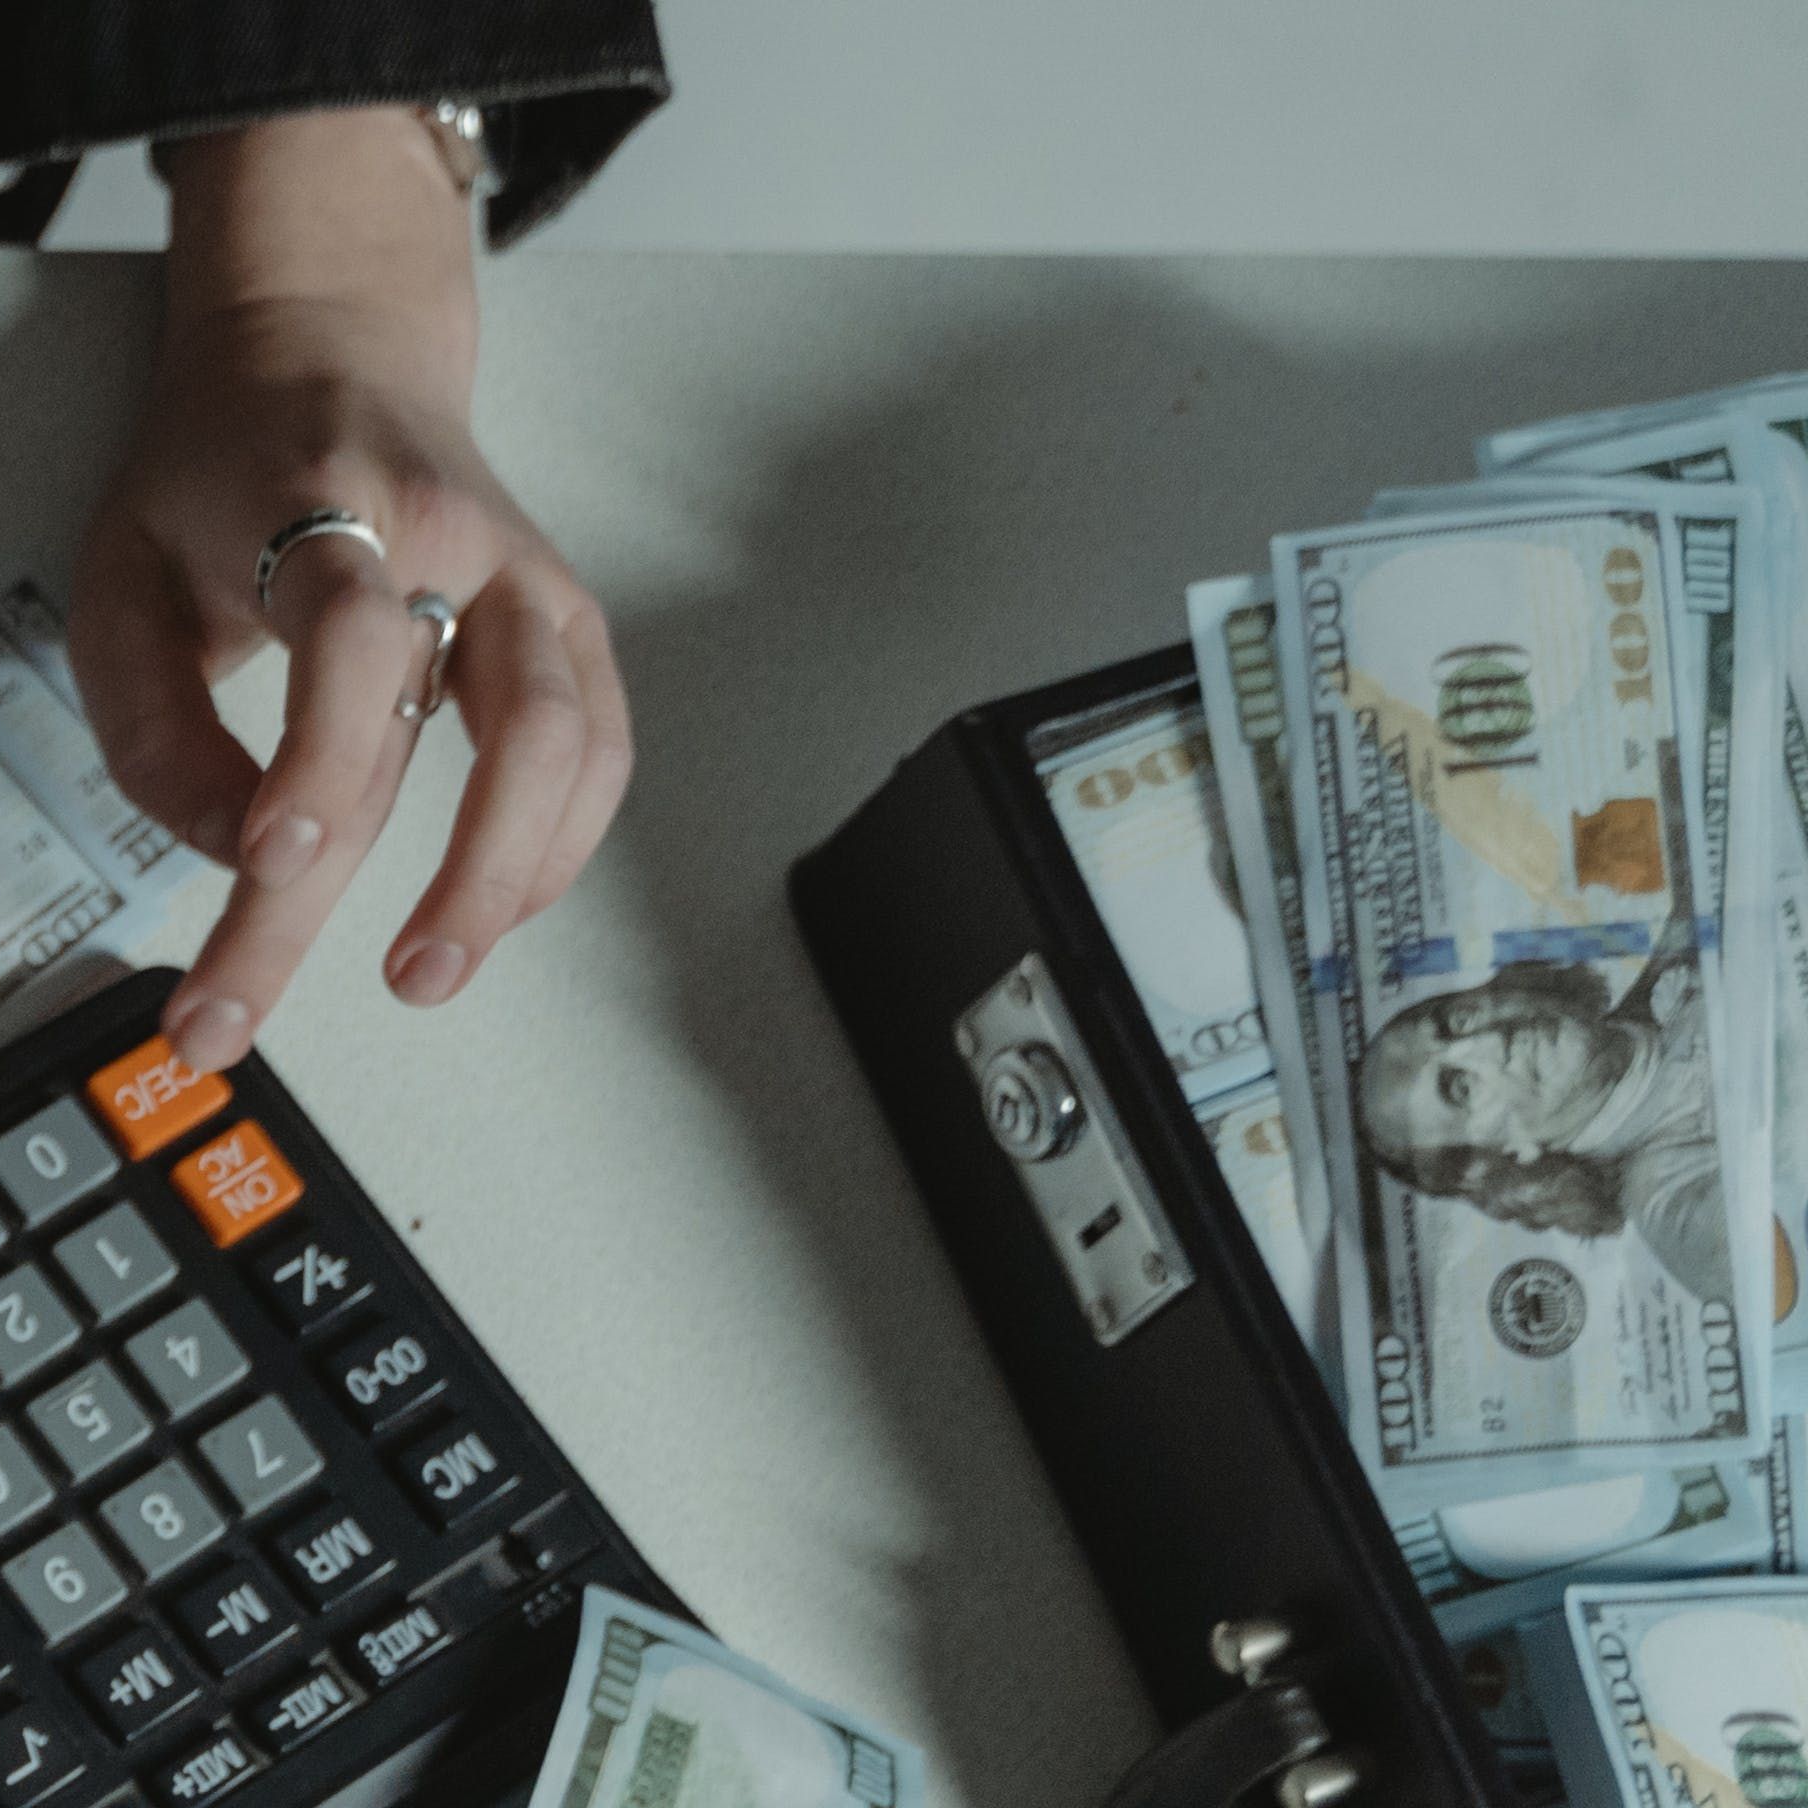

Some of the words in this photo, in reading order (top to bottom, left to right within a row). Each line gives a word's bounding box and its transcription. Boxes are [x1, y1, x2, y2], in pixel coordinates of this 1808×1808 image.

[1603, 547, 1653, 706] 100
[23, 1133, 67, 1180] 0
[198, 1135, 247, 1183] AC
[221, 1173, 277, 1220] ON
[95, 1238, 132, 1280] 1
[165, 1336, 200, 1379] 4
[66, 1391, 112, 1442] 5
[247, 1429, 284, 1479] 7
[421, 1432, 497, 1500] MC
[141, 1493, 182, 1540] 8
[294, 1517, 373, 1584] MR
[45, 1554, 87, 1606] 9
[206, 1583, 272, 1638] M-
[108, 1648, 174, 1706] M+
[595, 1629, 644, 1722] 100
